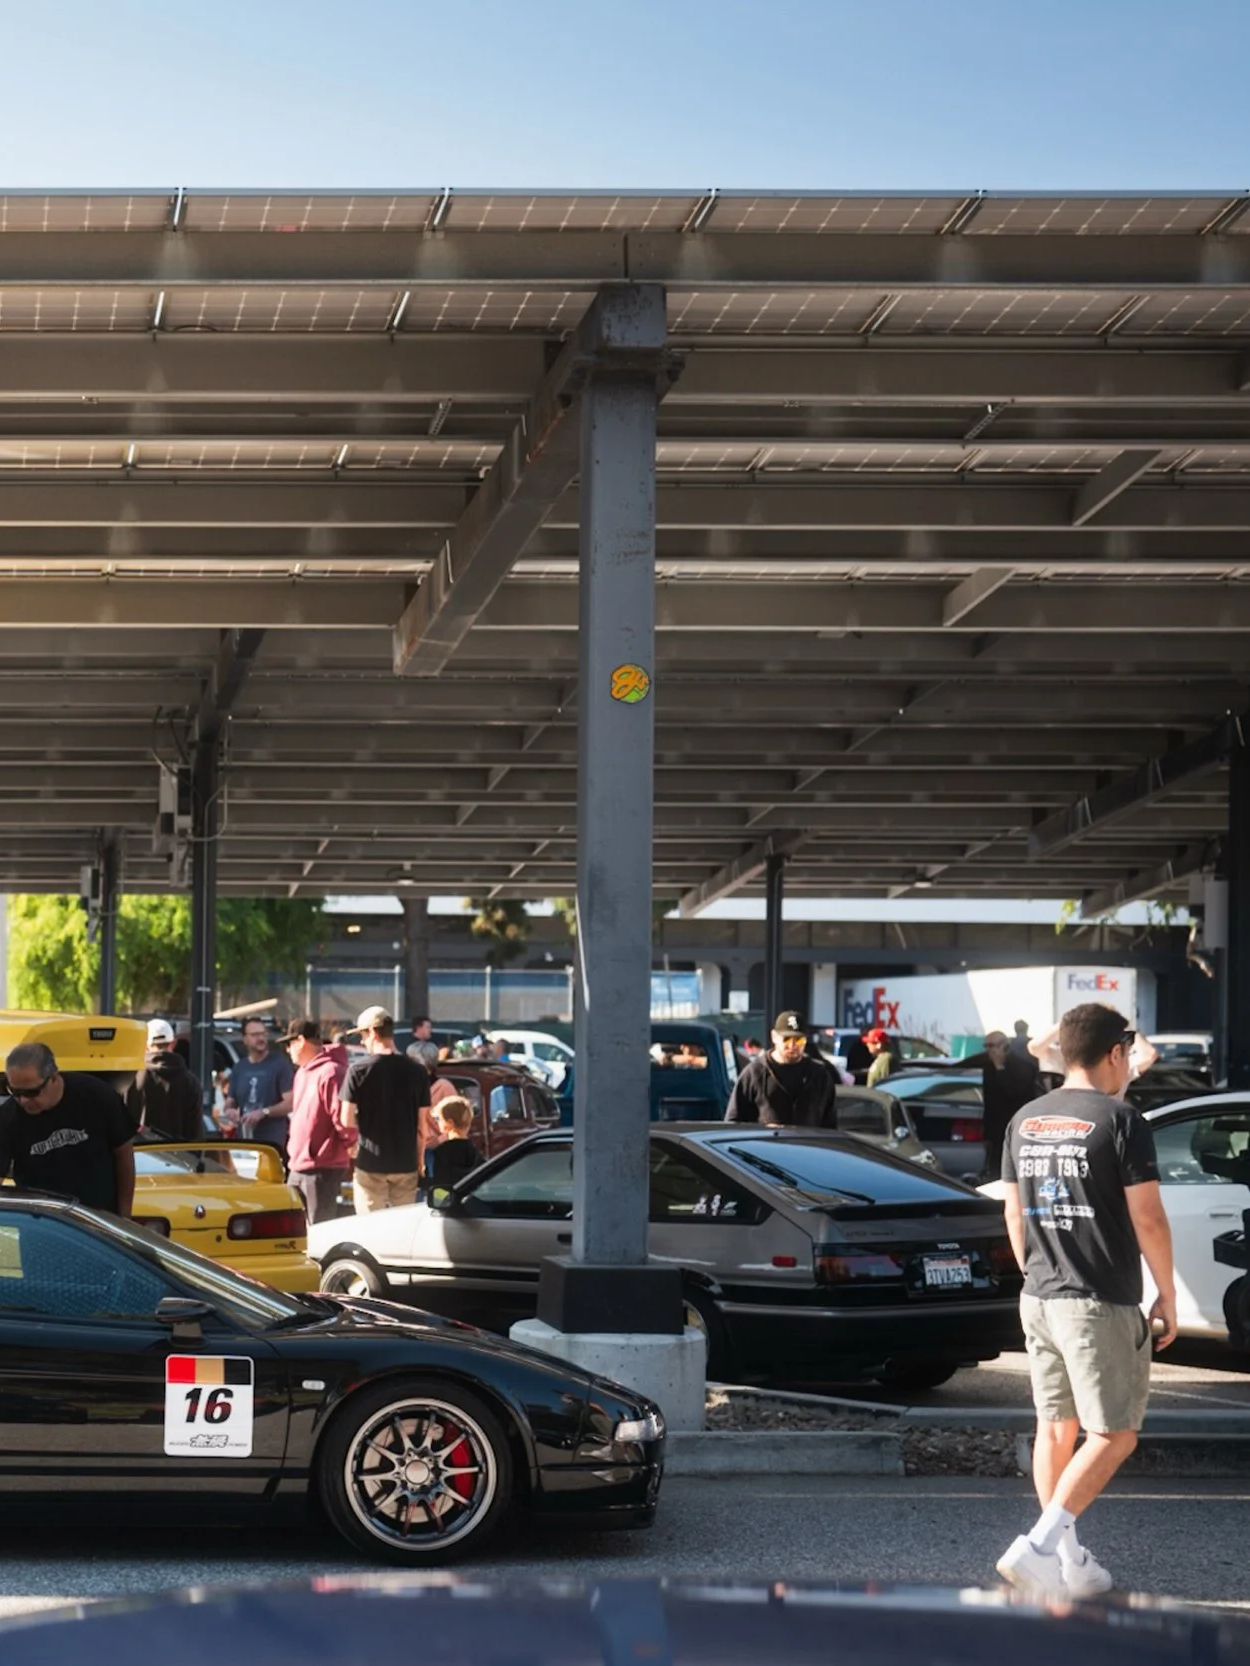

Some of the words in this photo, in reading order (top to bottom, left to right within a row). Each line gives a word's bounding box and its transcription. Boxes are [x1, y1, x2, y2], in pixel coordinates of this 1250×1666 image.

[1068, 974, 1119, 991] FedEx
[843, 988, 900, 1029] FedEx
[185, 1387, 234, 1424] 16
